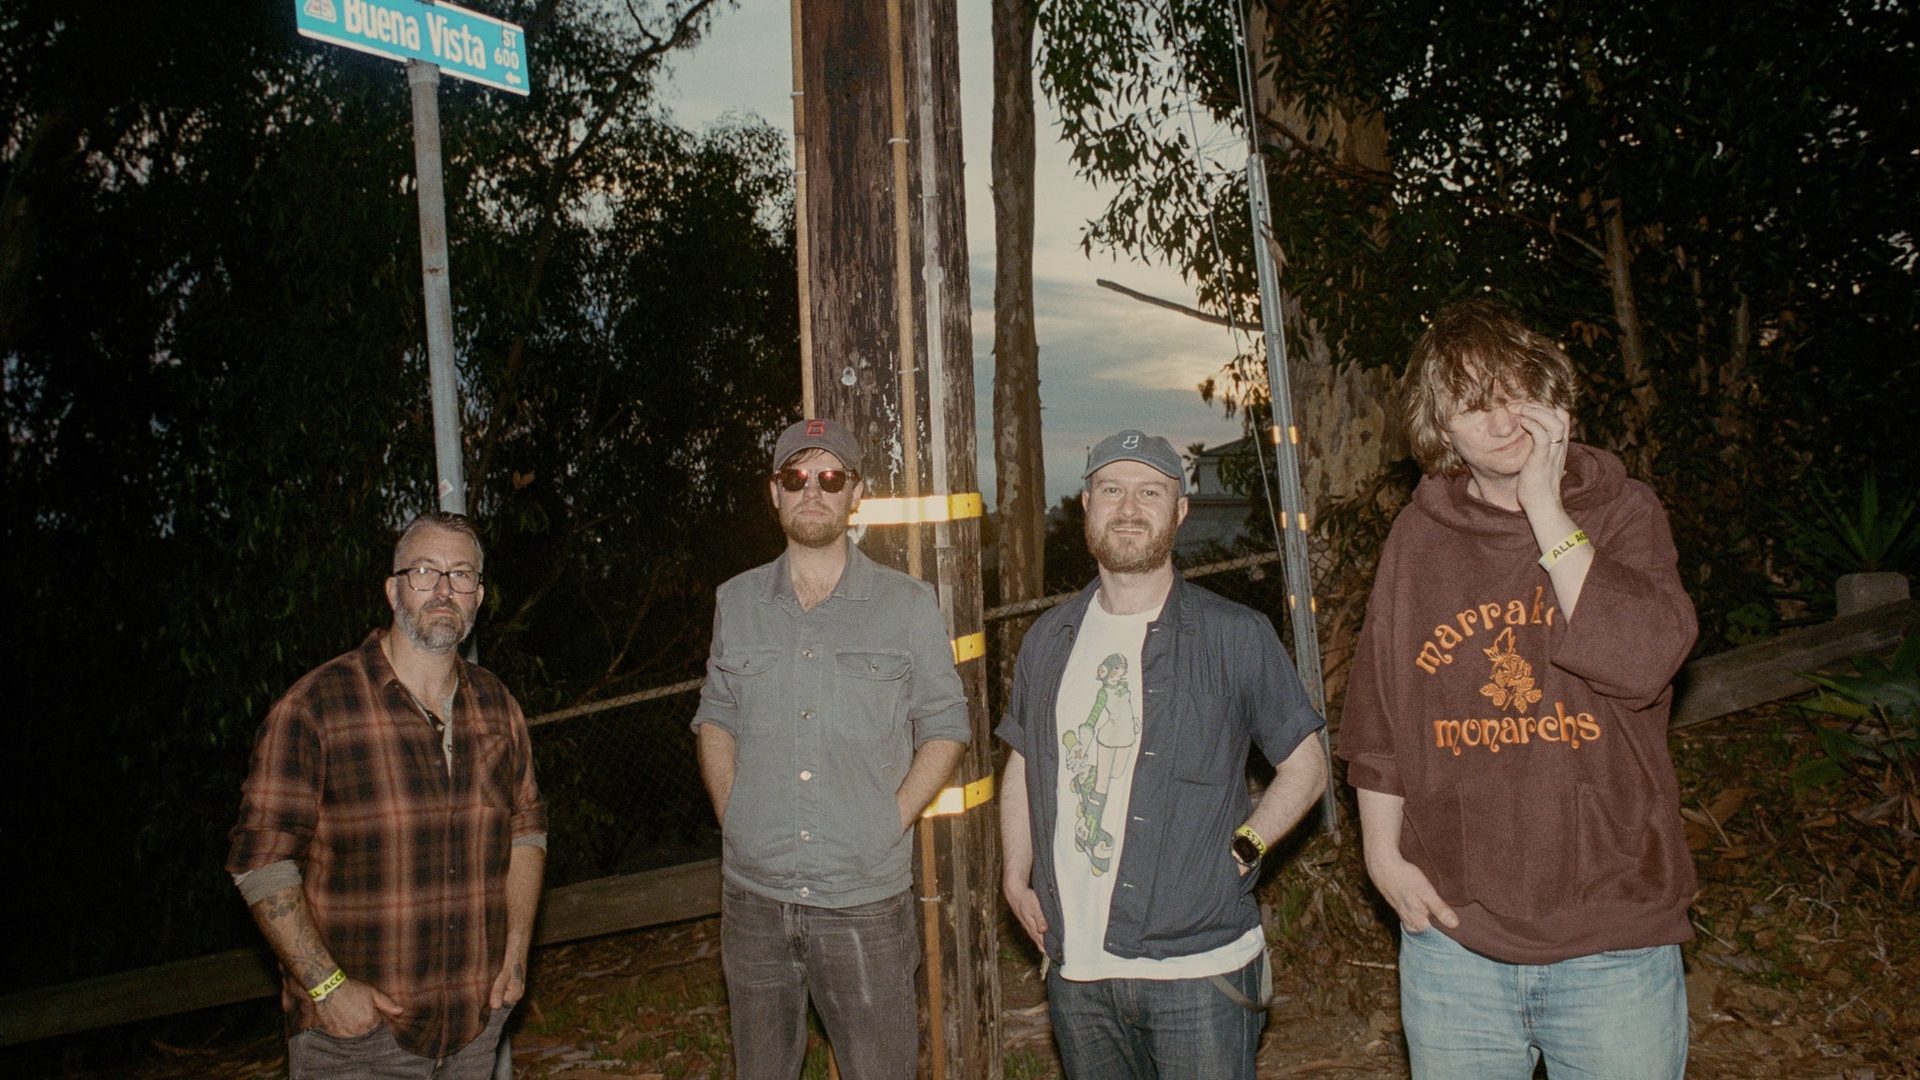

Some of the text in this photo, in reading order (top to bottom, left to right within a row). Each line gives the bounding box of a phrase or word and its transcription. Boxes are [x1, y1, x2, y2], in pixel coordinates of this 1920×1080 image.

[345, 0, 486, 70] Buena Vista
[503, 30, 516, 48] ST
[494, 48, 519, 70] 600
[1552, 540, 1575, 558] ALL
[1433, 701, 1601, 756] monarchs
